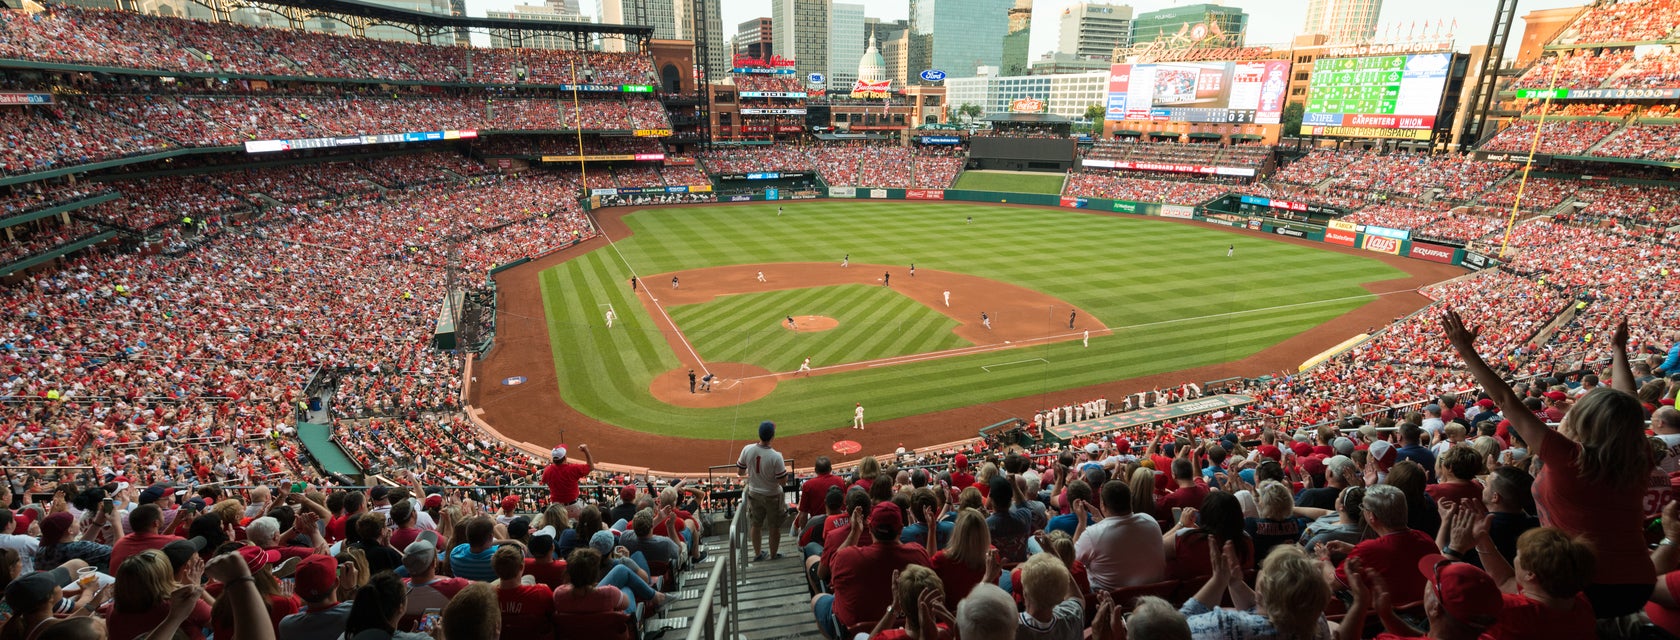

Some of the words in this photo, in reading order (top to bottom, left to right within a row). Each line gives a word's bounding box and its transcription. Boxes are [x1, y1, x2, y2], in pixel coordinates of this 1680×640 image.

[1330, 46, 1366, 56] WORLD
[1369, 44, 1438, 54] CHAMPIONS
[733, 53, 770, 68] Cardinals
[769, 54, 794, 67] Nation
[926, 71, 941, 79] Ford
[853, 81, 890, 91] Budweiser
[1572, 90, 1602, 98] THAT'S
[1604, 90, 1612, 98] A
[1238, 114, 1244, 122] 2
[1248, 114, 1253, 122] 1
[1311, 114, 1334, 122] STIFEL
[1352, 117, 1395, 126] CARPENTERS
[1399, 118, 1423, 126] UNION
[1487, 154, 1504, 162] Mercy
[1412, 246, 1450, 259] EQUIFAX
[756, 455, 761, 473] 1
